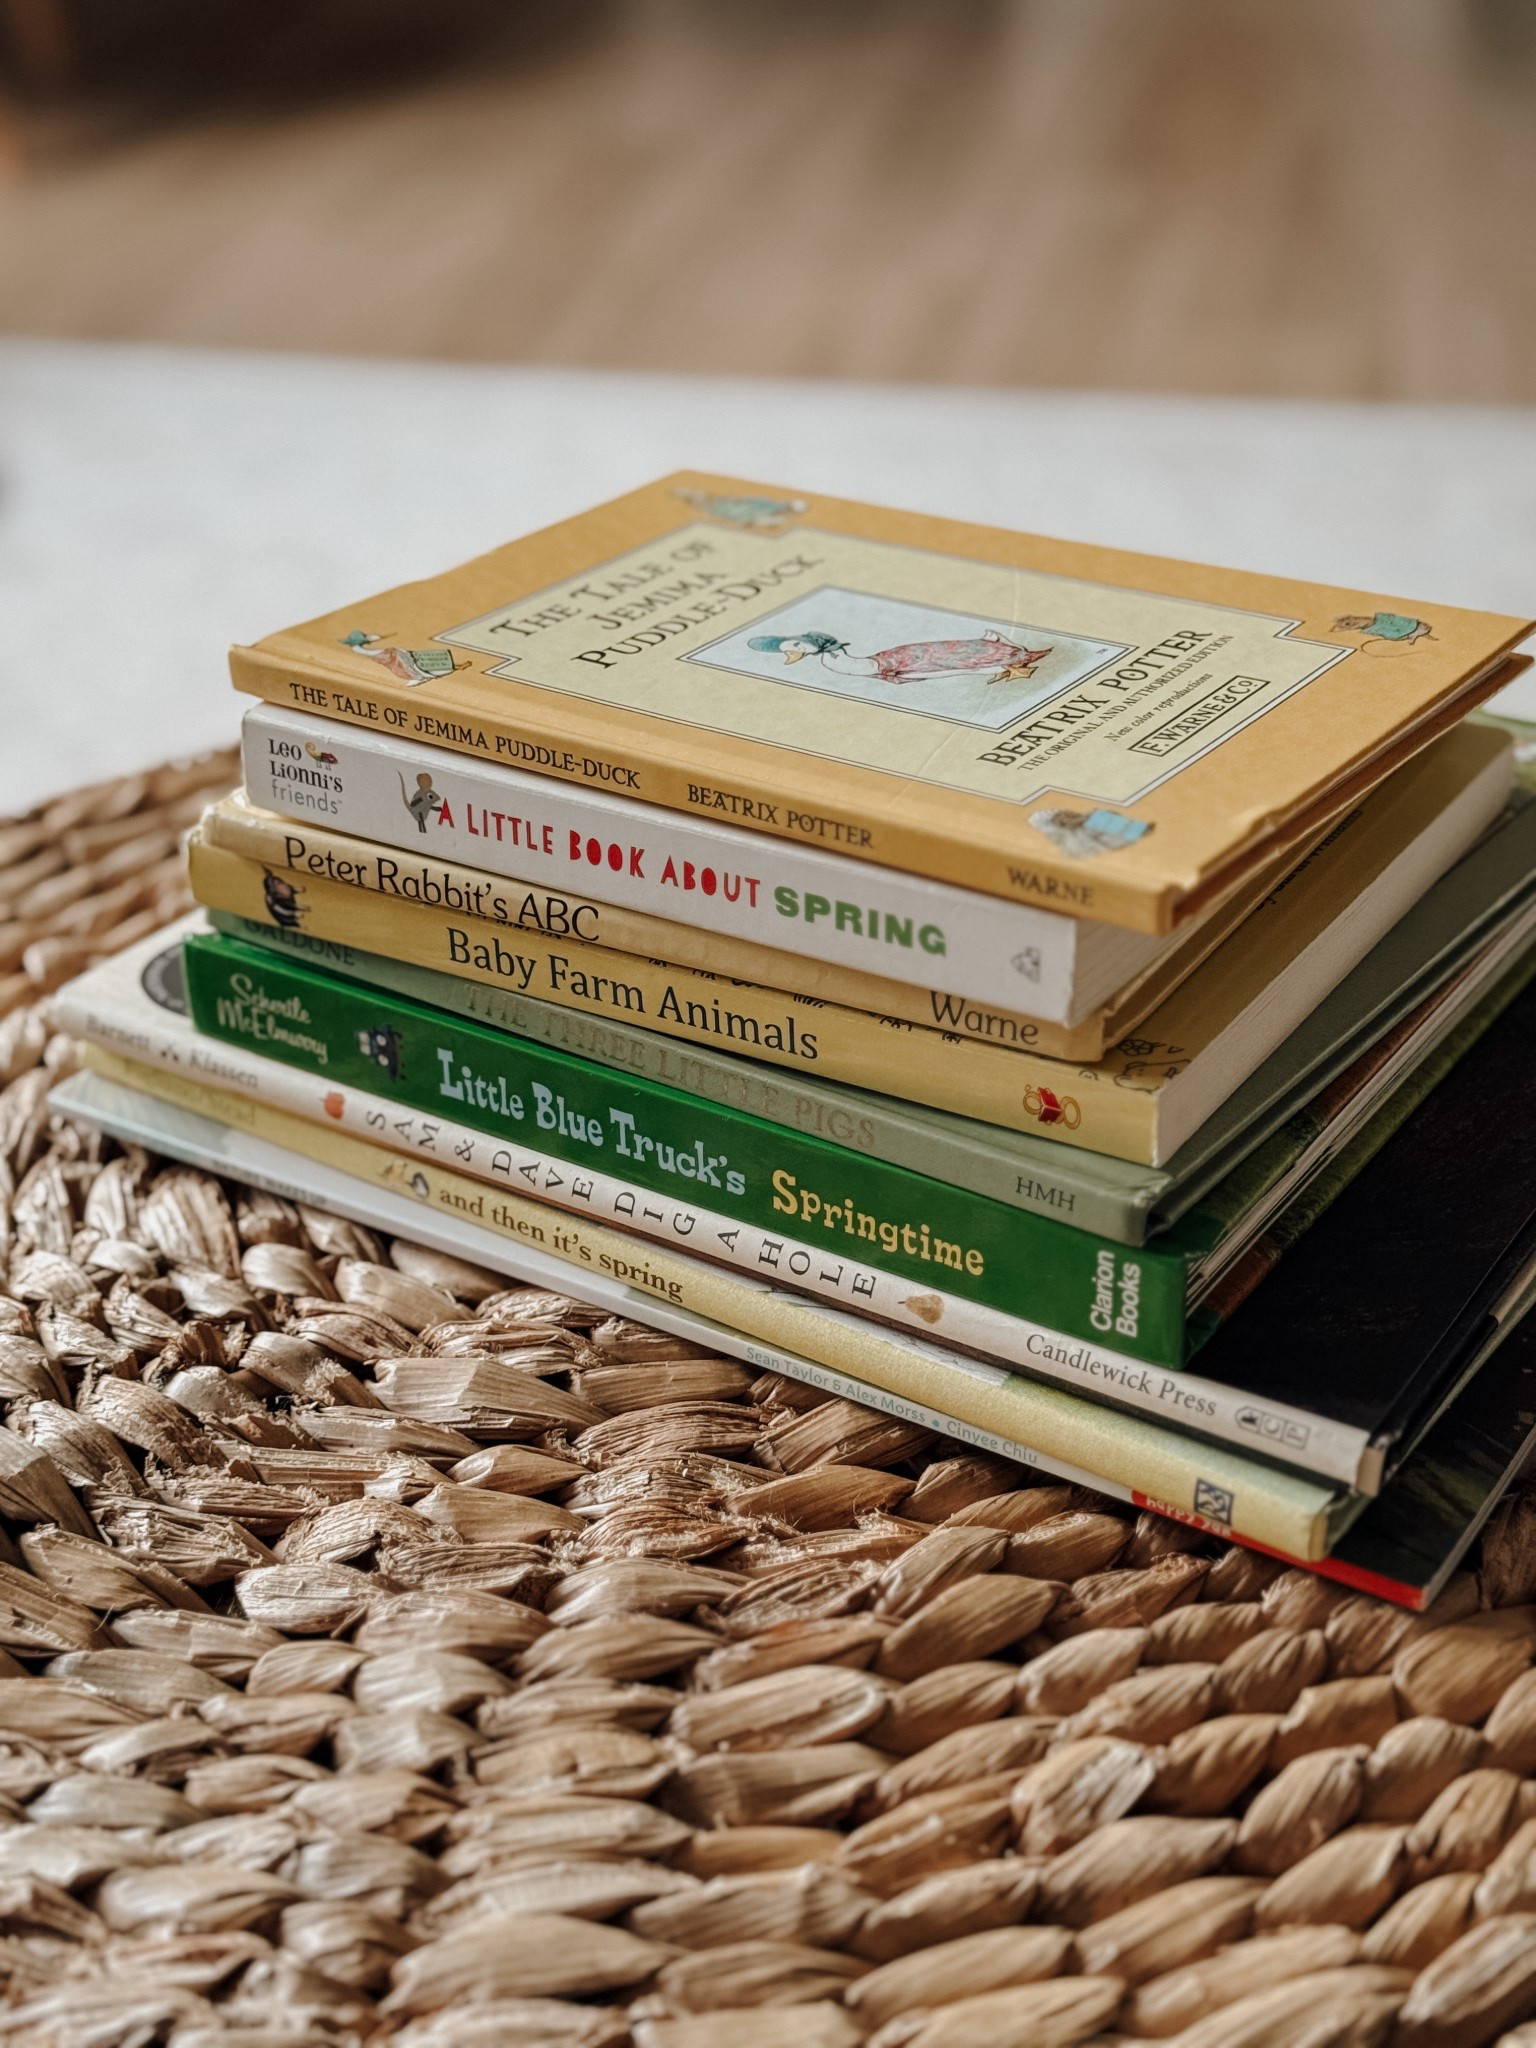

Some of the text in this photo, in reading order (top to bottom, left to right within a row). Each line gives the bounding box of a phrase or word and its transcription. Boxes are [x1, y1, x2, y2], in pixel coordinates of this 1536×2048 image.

[489, 601, 581, 638] THE
[569, 560, 672, 611] TALE
[569, 554, 825, 669] PUDDLE-DUCK
[586, 570, 731, 630] JEMIMA
[976, 629, 1213, 766] BEATRIX POTTER
[1017, 635, 1235, 771] THE ORIGINAL AND AUTHORIZED EDITION
[1104, 672, 1213, 742] New color reproductions
[289, 681, 1094, 906] THE TALE OF JEMIMA PUDDLE-DUCK BEATRIX POTTER WARNE
[437, 798, 948, 957] A LITTLE BOOK ABOUT SPRING
[284, 836, 1038, 1046] Peter Rabbit's ABC Warne
[447, 927, 819, 1060] Baby Farm Animals
[437, 1047, 746, 1195] Little Blue Truck's
[464, 984, 527, 1028] THE
[796, 1099, 874, 1150] PIGS
[1016, 1176, 1077, 1212] HMH
[366, 1109, 1217, 1418] SAM & DAVE DIG A HOLE Candlewick Press
[440, 1186, 683, 1304] and then it's spring
[772, 1169, 984, 1277] Springtime
[1090, 1250, 1115, 1331] Clarion
[1115, 1262, 1141, 1337] Books
[746, 1346, 781, 1371] Sean
[783, 1362, 831, 1392] Taylor
[845, 1377, 877, 1404] Alex
[880, 1394, 926, 1423] Morss
[946, 1420, 998, 1451] Cinyee
[1002, 1438, 1038, 1464] Chiu
